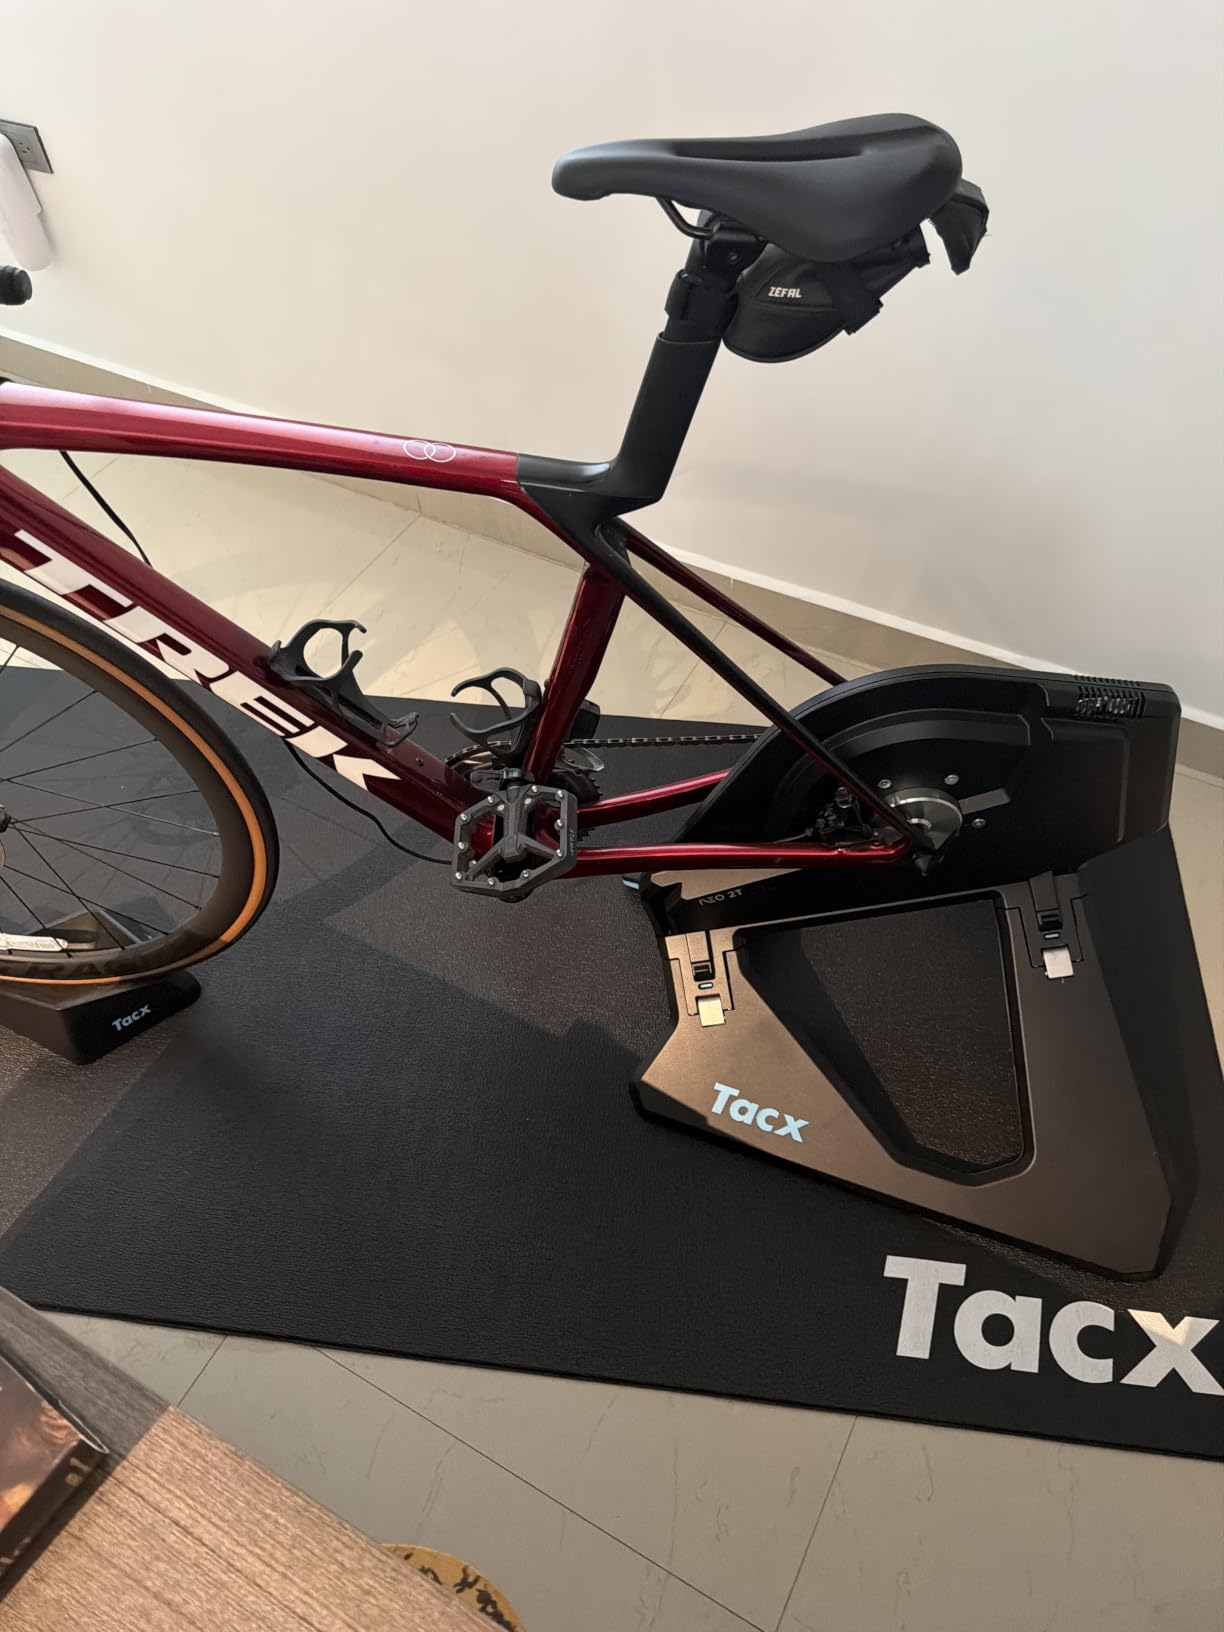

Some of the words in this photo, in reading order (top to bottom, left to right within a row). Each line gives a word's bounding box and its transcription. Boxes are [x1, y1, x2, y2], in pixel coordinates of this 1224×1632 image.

[14, 529, 401, 791] TREK
[727, 888, 742, 898] 2T
[112, 1004, 151, 1031] Tacx
[712, 1082, 810, 1143] Tacx
[883, 1255, 1224, 1396] Tacx
